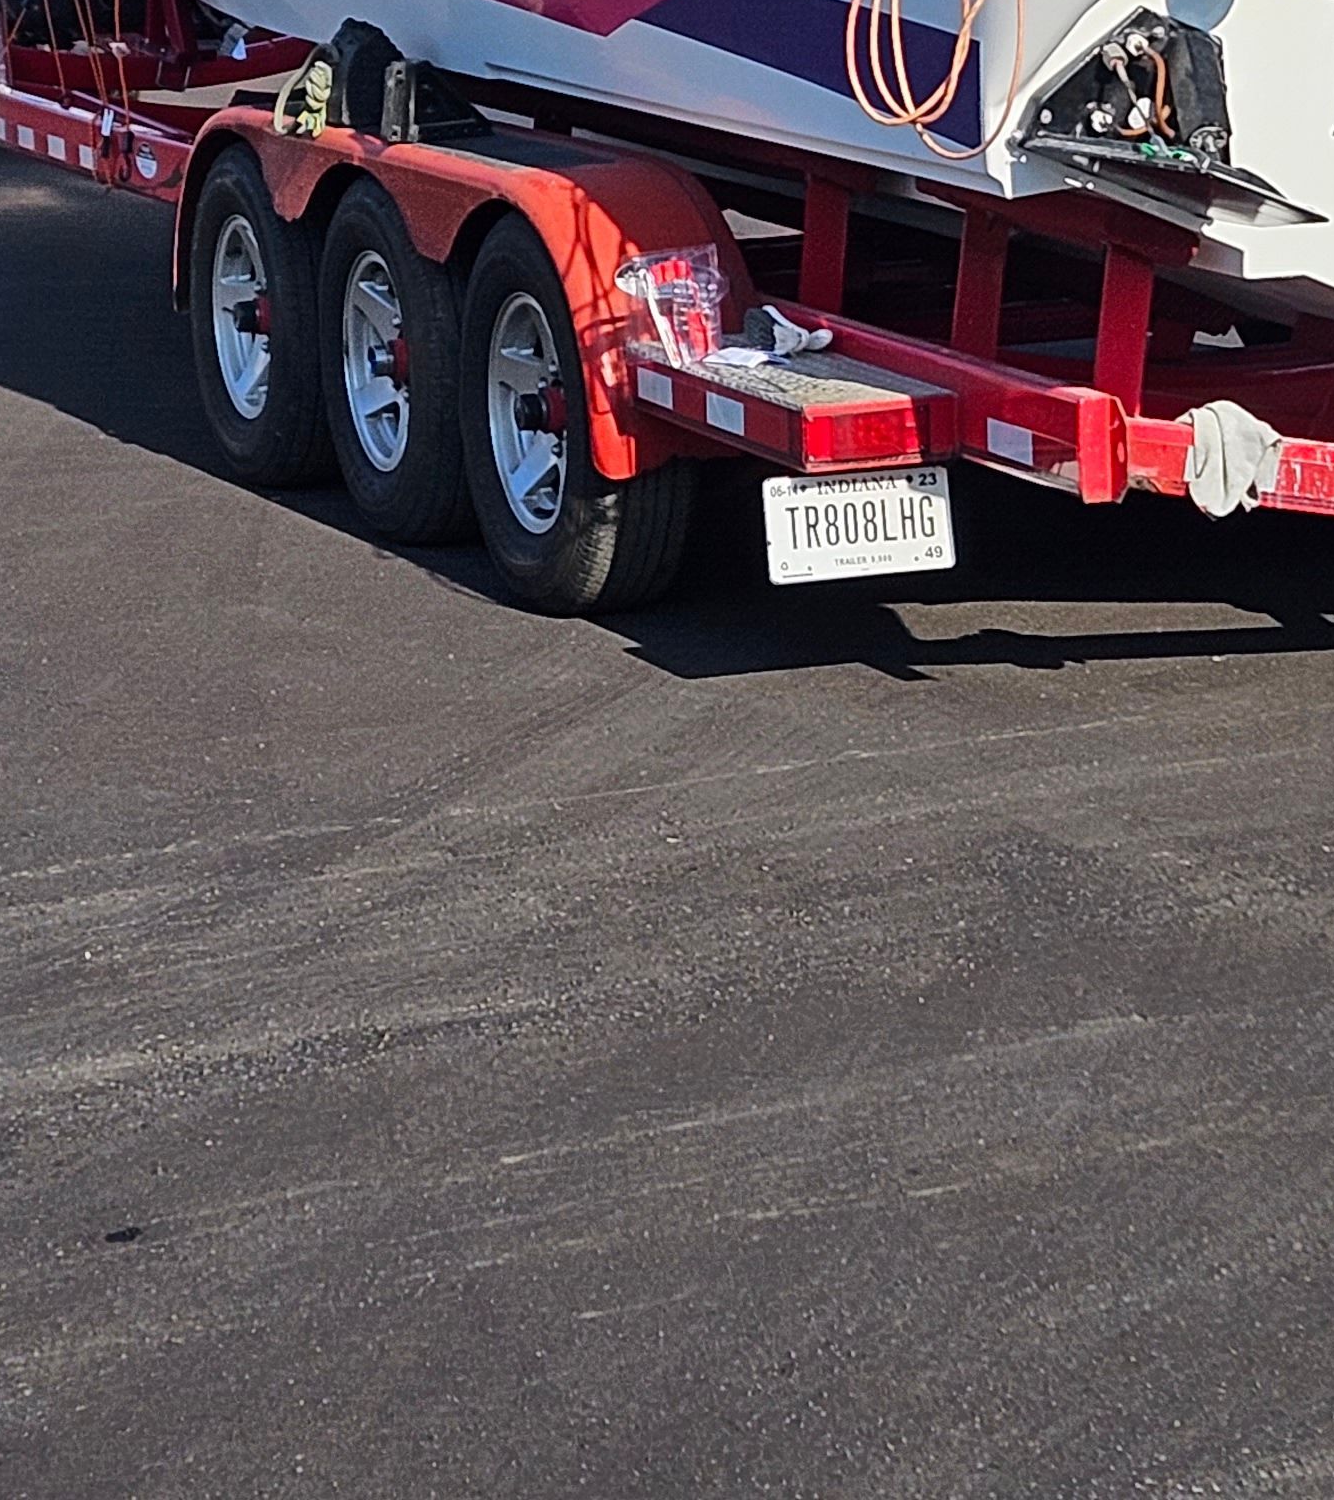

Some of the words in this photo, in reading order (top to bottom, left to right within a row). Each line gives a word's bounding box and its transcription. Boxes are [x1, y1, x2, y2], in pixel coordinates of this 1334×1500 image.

[817, 475, 898, 496] INDIANA
[918, 472, 938, 487] 23
[785, 495, 936, 550] TR808LHG
[835, 556, 867, 567] TRAILER
[924, 545, 943, 559] 49
